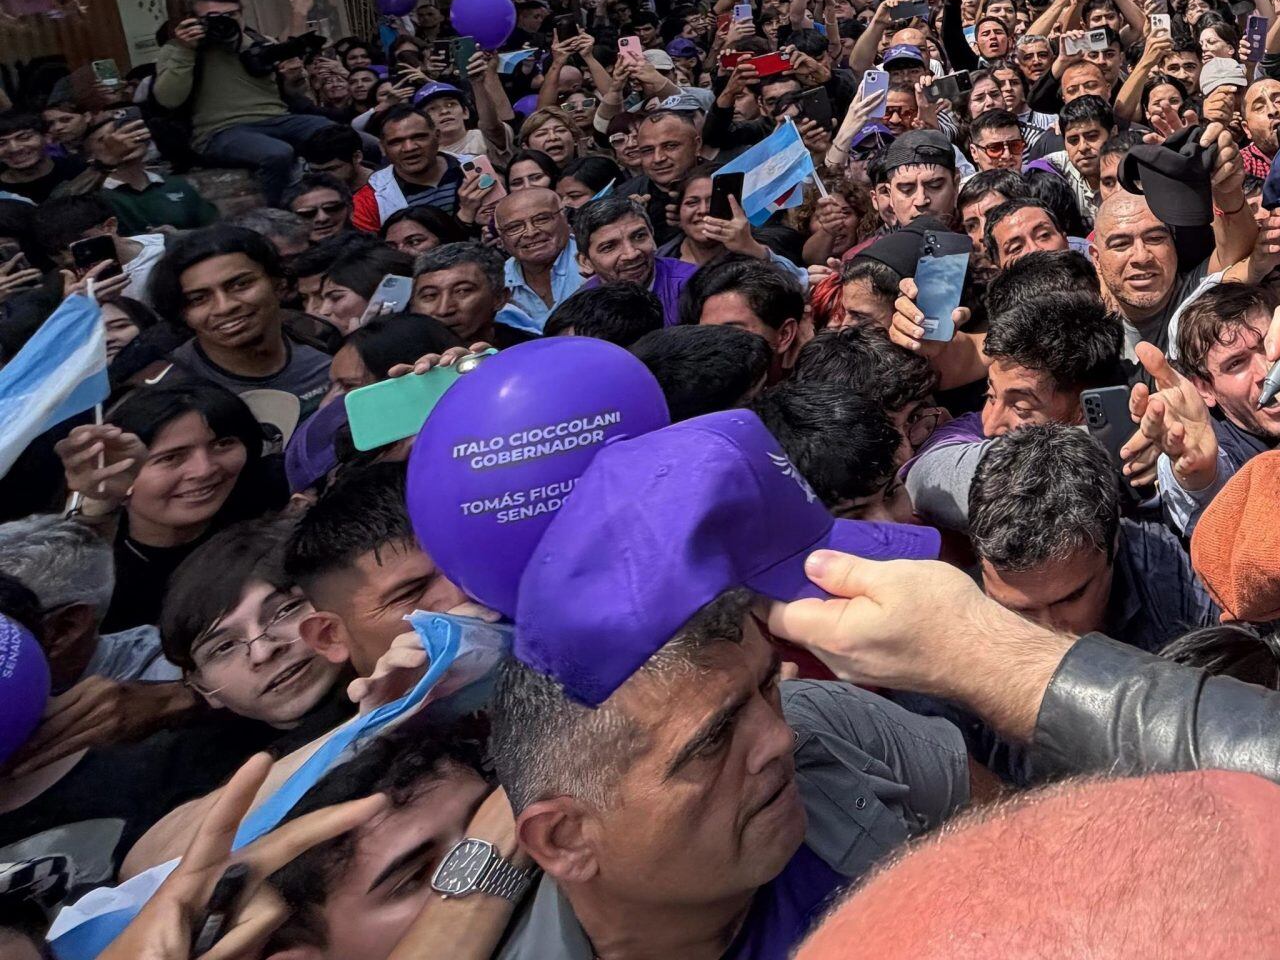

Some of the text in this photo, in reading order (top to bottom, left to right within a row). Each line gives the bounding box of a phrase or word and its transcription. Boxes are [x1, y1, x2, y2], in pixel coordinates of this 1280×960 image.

[453, 411, 621, 458] ITALO CIOCCOLANI
[471, 430, 604, 469] GOBERNADOR
[460, 491, 525, 515] TOMÁS
